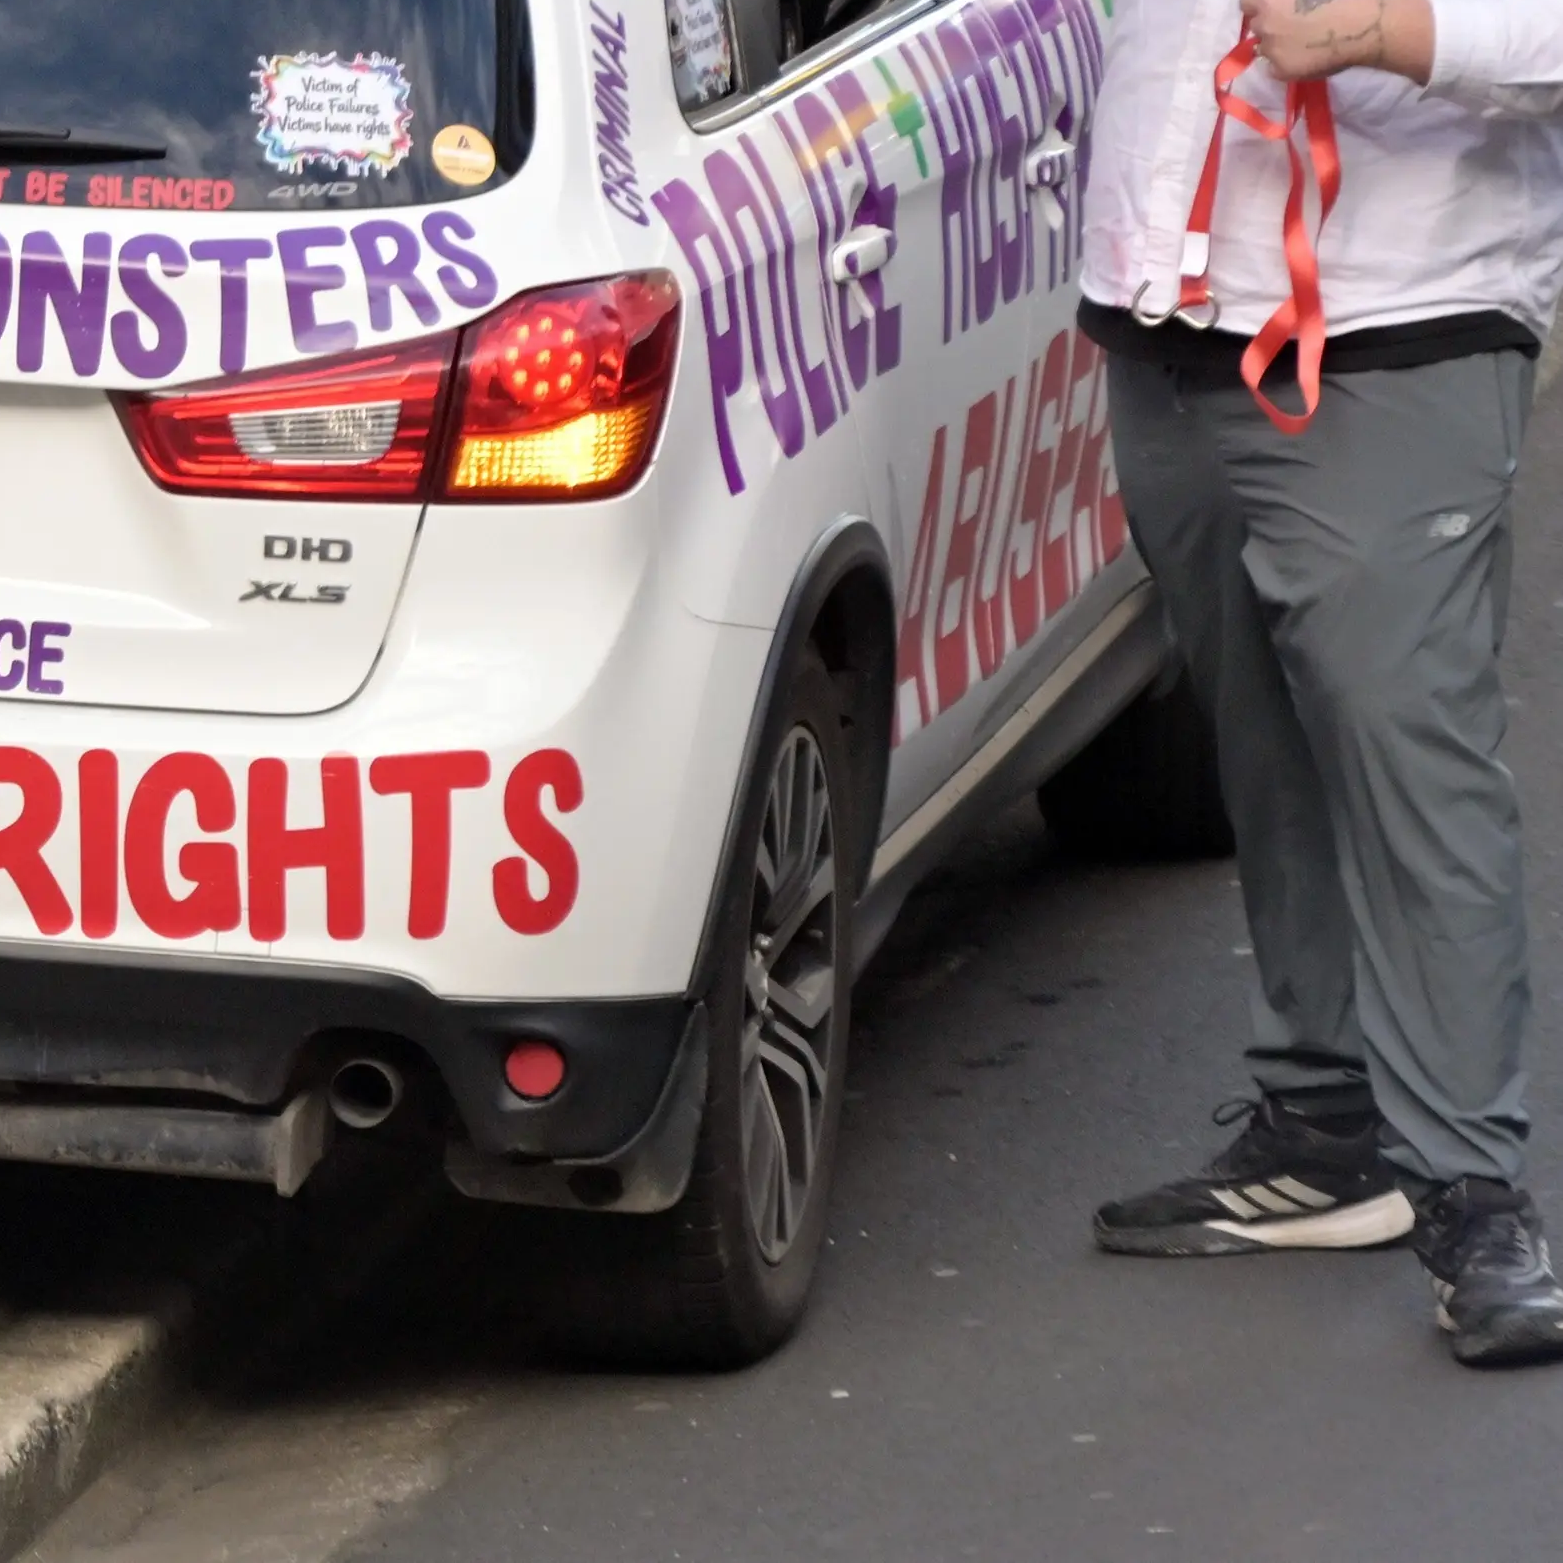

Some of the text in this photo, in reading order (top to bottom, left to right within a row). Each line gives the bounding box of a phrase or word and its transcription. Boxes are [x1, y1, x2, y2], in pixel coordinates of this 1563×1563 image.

[301, 76, 360, 97] Victim of
[285, 96, 380, 116] Police Failures
[590, 0, 650, 228] CRIMINAL
[277, 116, 391, 140] Victims have rights
[24, 170, 70, 206] BE
[87, 175, 235, 210] SILENCED
[267, 181, 358, 199] 4WD
[650, 69, 903, 496] POLICE
[237, 579, 351, 605] XLS
